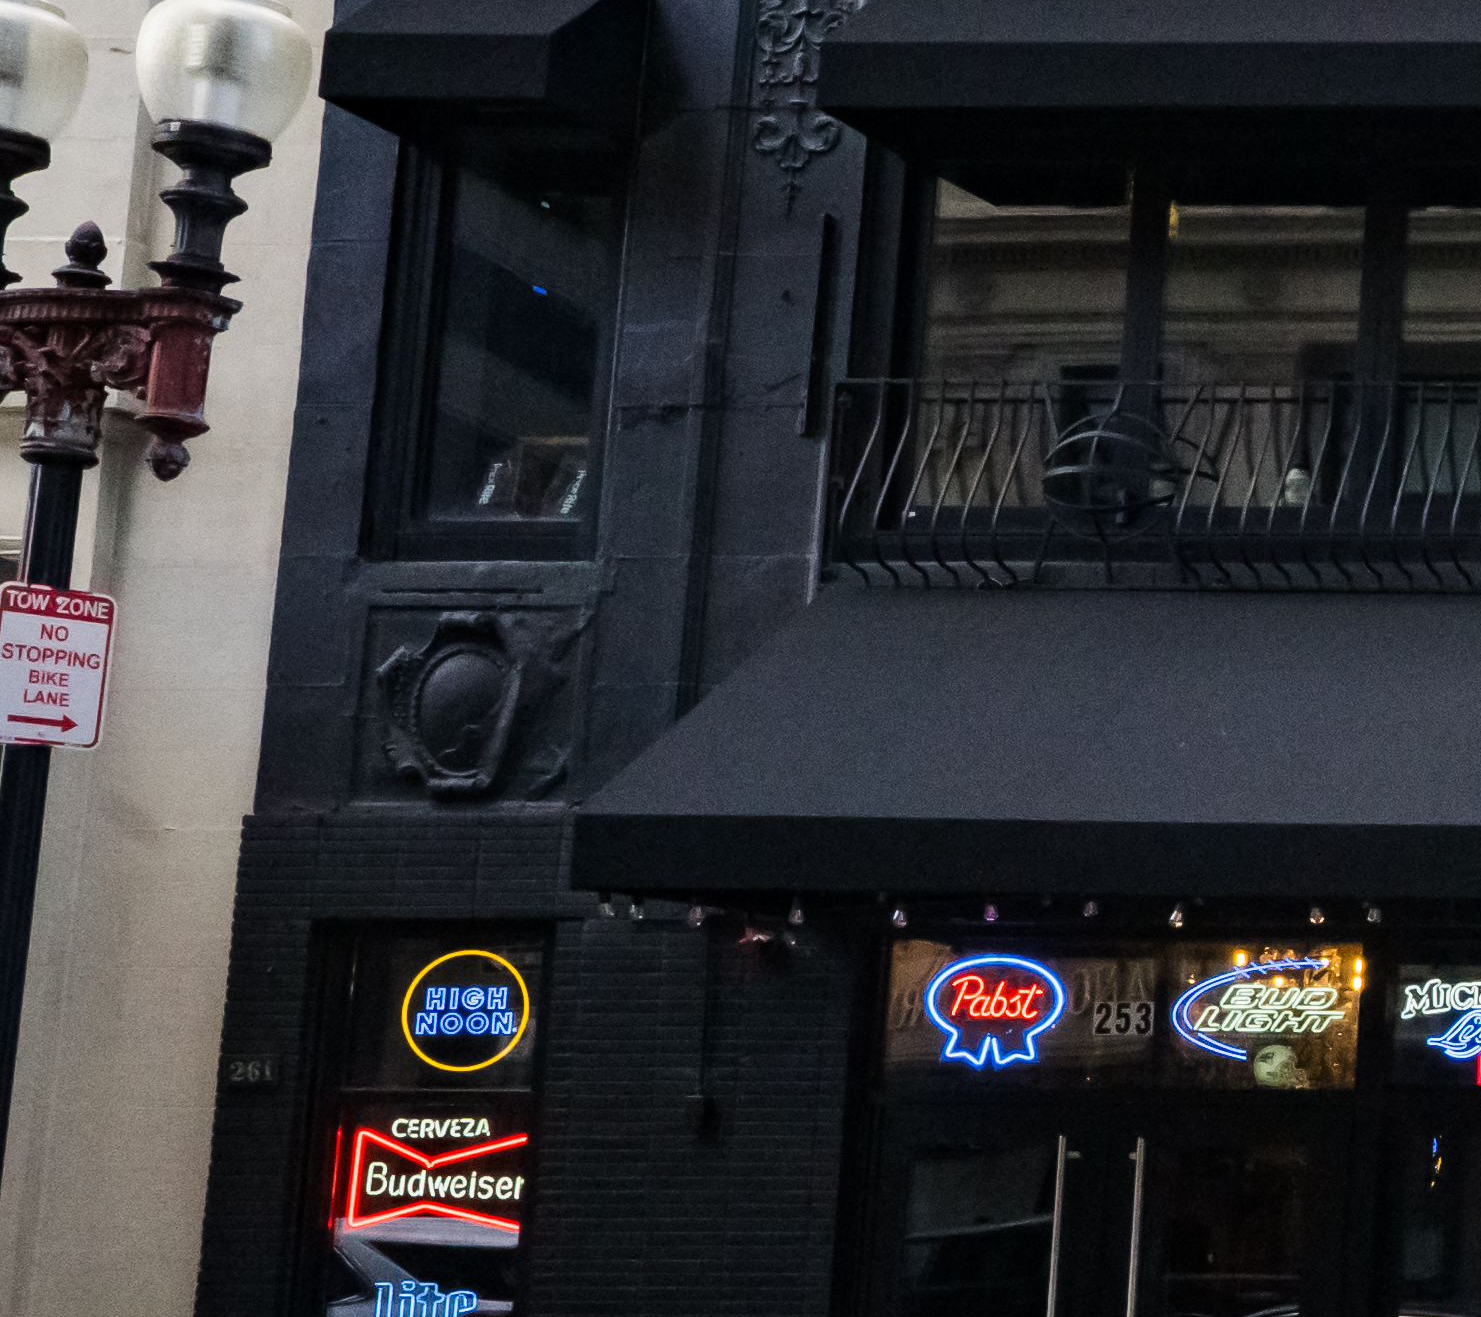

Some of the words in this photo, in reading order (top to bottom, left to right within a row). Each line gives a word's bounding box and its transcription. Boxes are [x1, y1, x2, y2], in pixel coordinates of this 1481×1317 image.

[7, 590, 50, 610] TOW
[55, 596, 109, 619] ZONE
[40, 624, 69, 642] NO
[2, 643, 100, 669] STOPPING
[29, 669, 70, 687] BIKE
[23, 689, 70, 707] LANE
[425, 986, 508, 1011] HIGH
[951, 974, 1044, 1020] Pabst
[1221, 984, 1338, 1010] BUD
[1096, 1002, 1151, 1034] 253
[1194, 1006, 1345, 1033] LIGHT
[391, 1118, 490, 1139] CERVEZA
[365, 1161, 524, 1200] Budweiser
